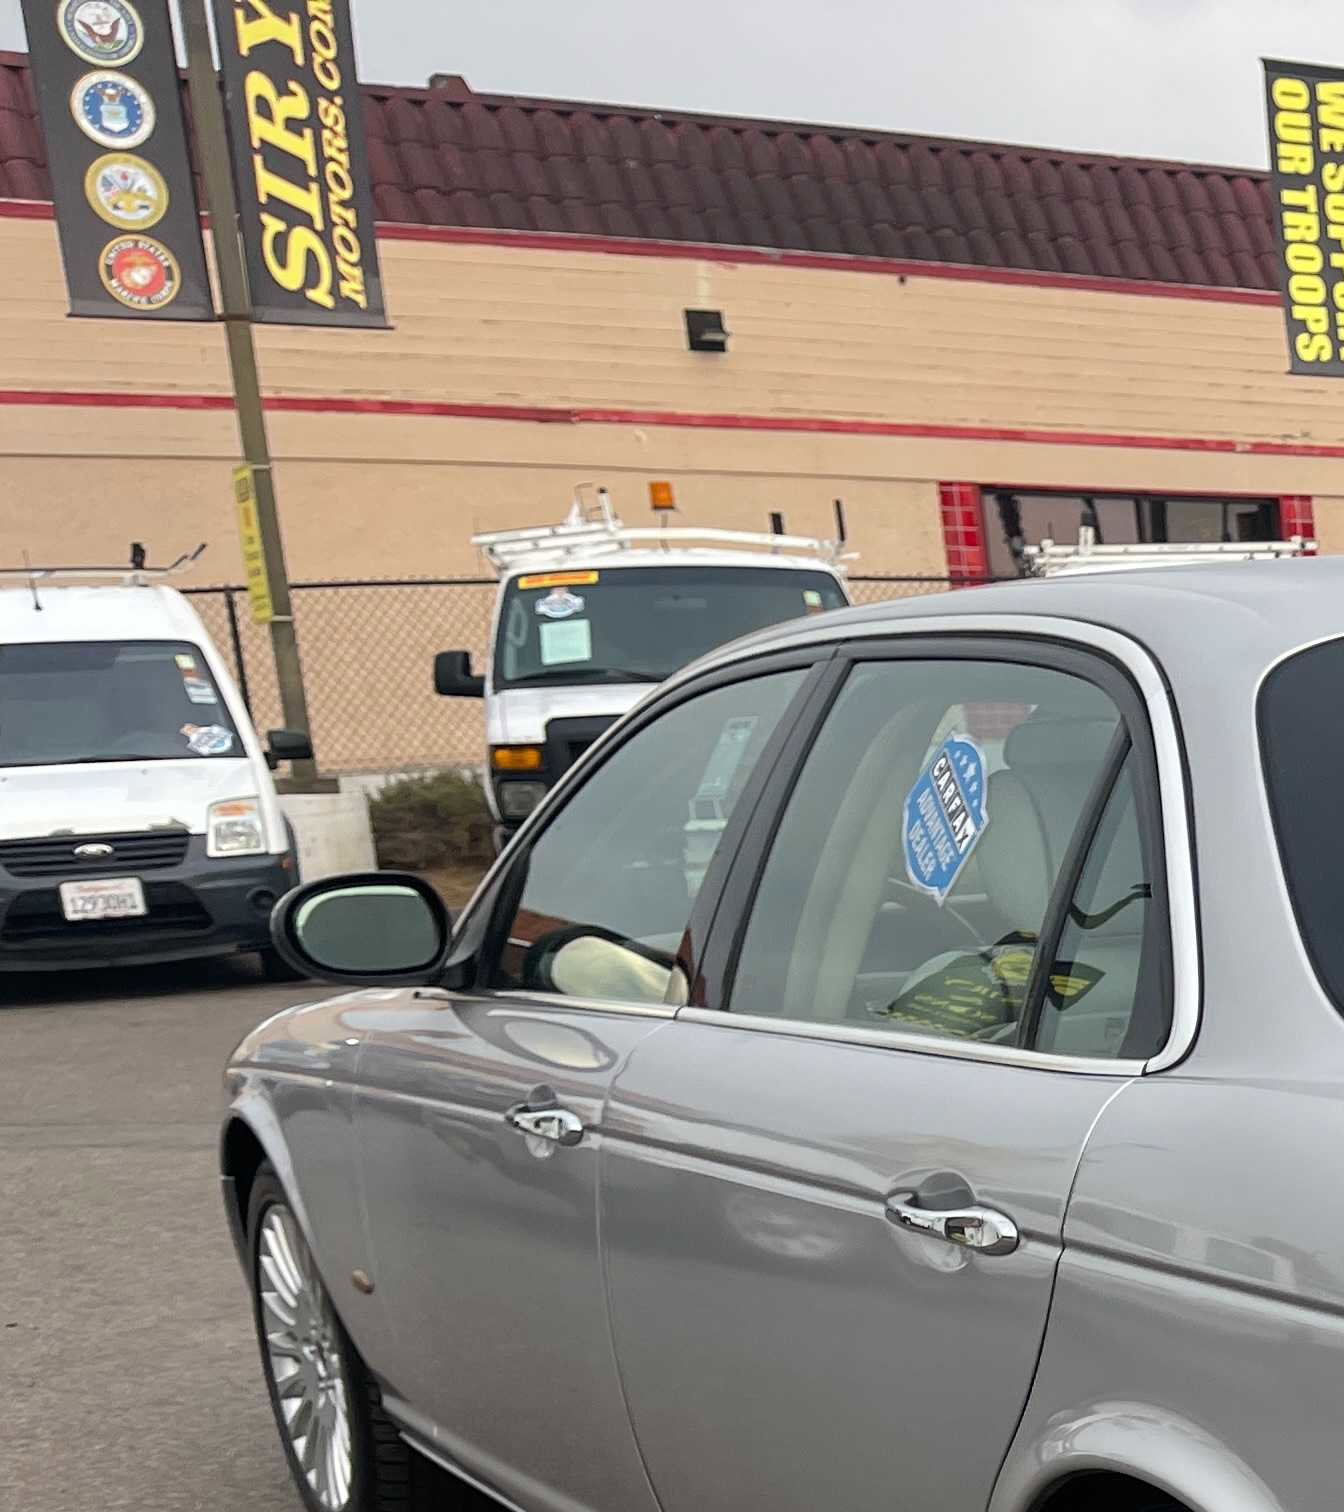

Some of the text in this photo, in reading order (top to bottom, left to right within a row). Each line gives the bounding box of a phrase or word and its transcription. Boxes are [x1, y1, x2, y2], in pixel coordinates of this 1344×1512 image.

[234, 0, 336, 310] SIRY
[1271, 77, 1333, 362] OUR TROOPS
[908, 819, 938, 881] DEALER
[916, 787, 957, 872] ADVANTAGE
[933, 757, 977, 855] CARFAX
